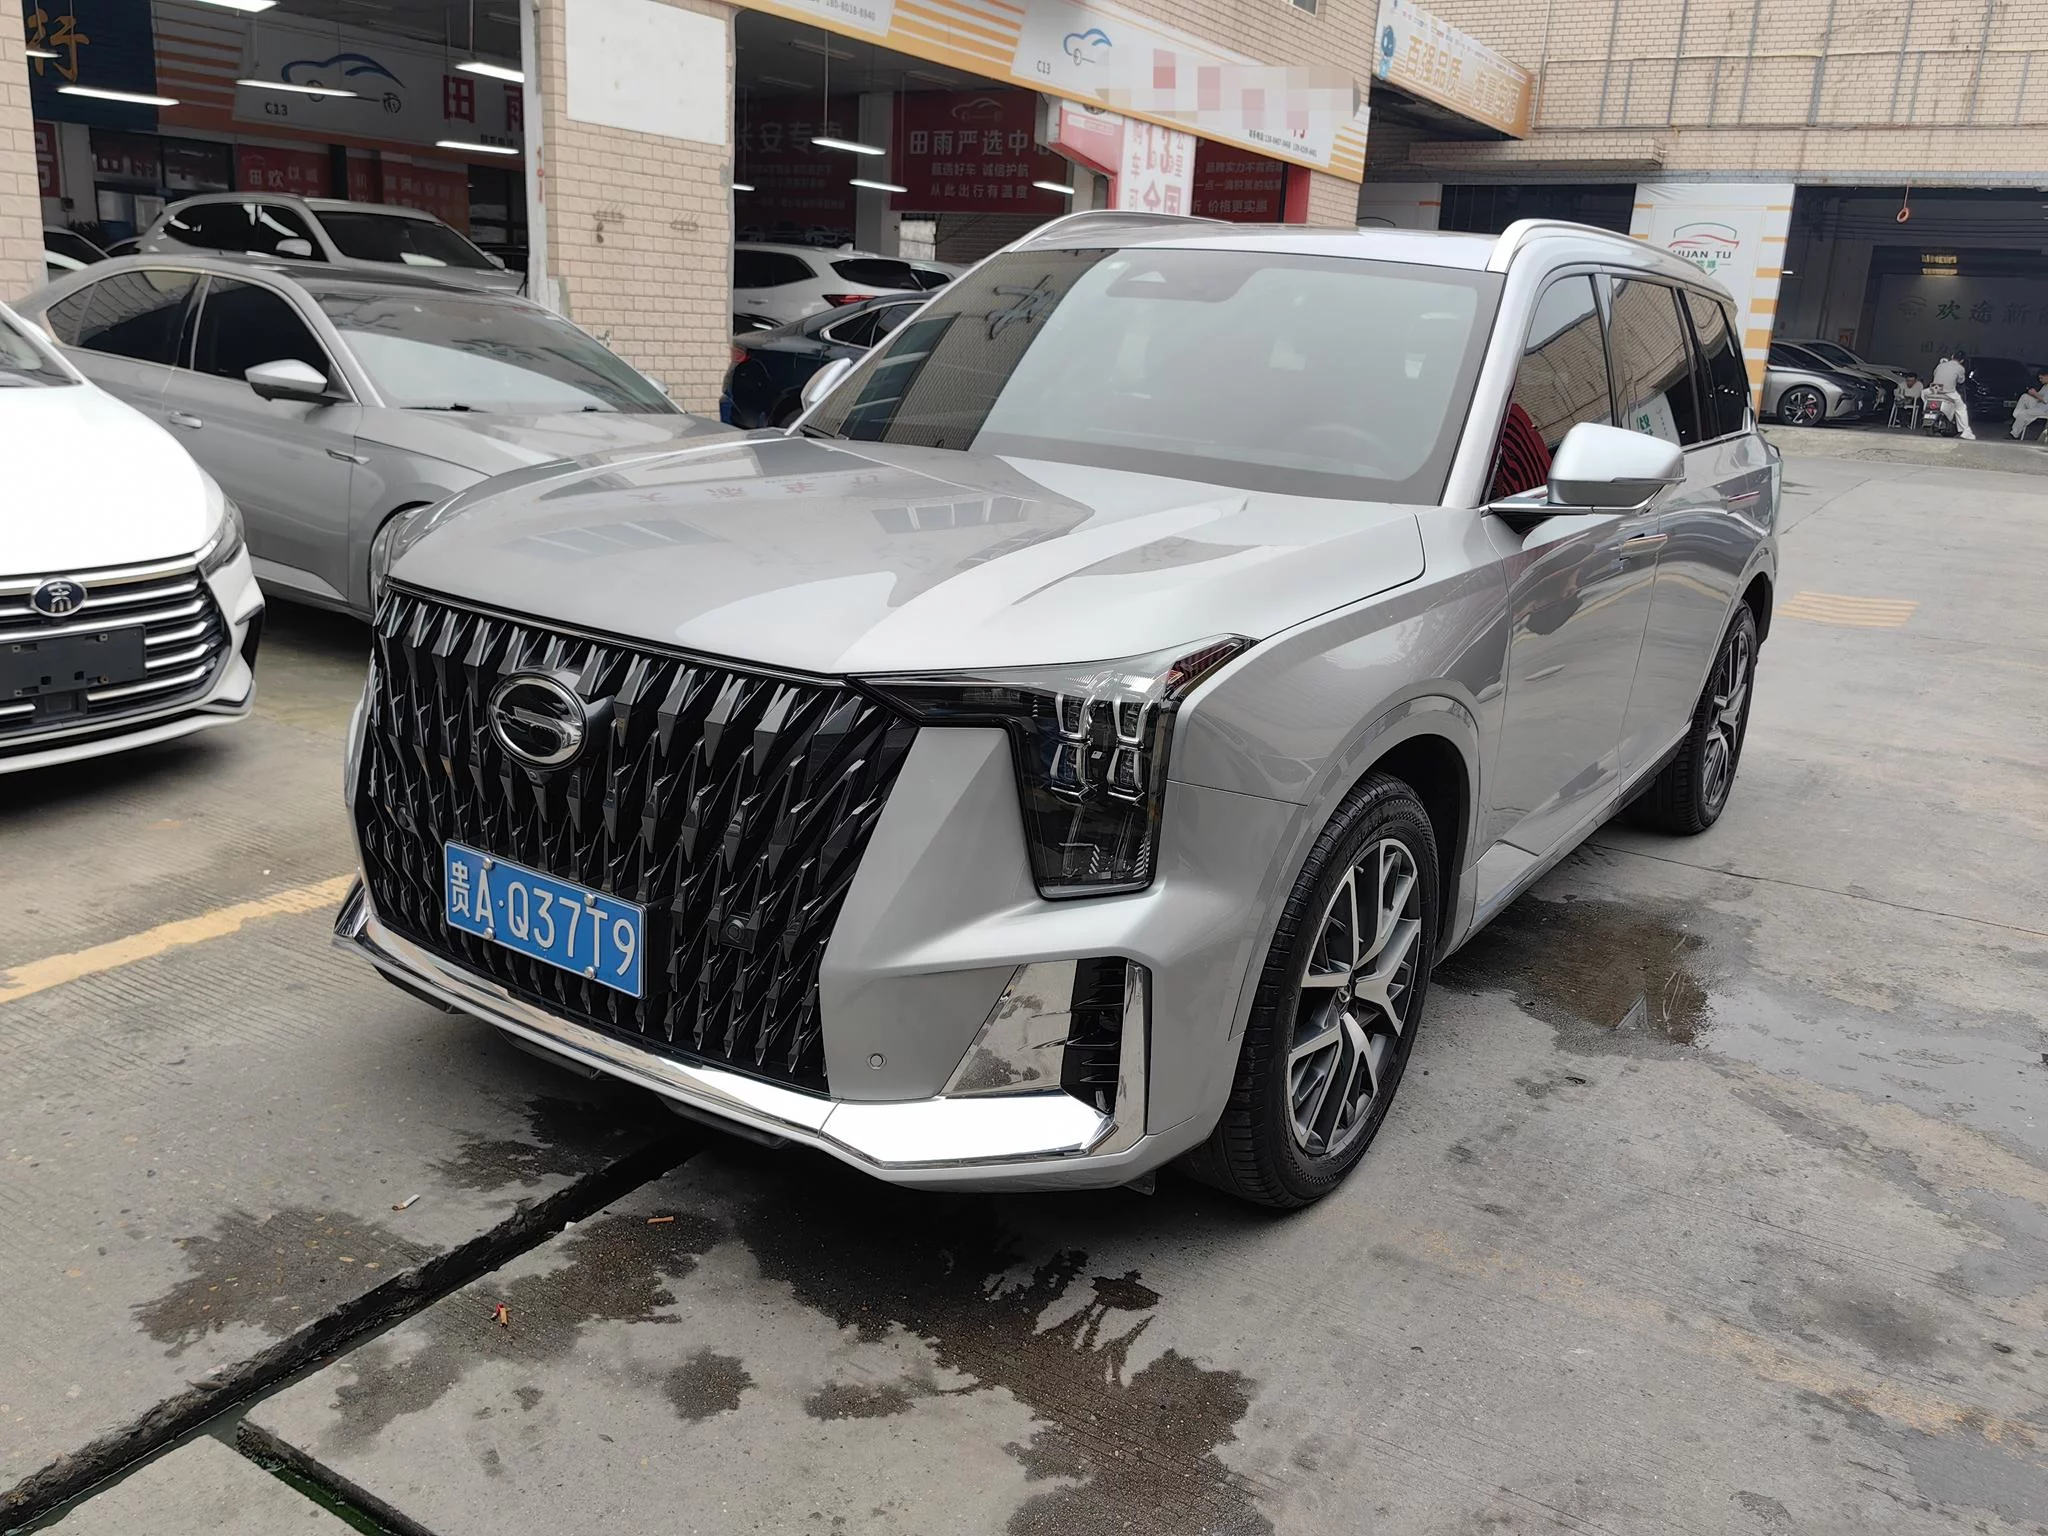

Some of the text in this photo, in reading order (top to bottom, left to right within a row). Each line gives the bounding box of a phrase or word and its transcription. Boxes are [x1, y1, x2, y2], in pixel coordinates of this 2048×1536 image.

[1037, 60, 1051, 75] C13
[265, 102, 288, 116] C13
[1714, 251, 1732, 259] TU
